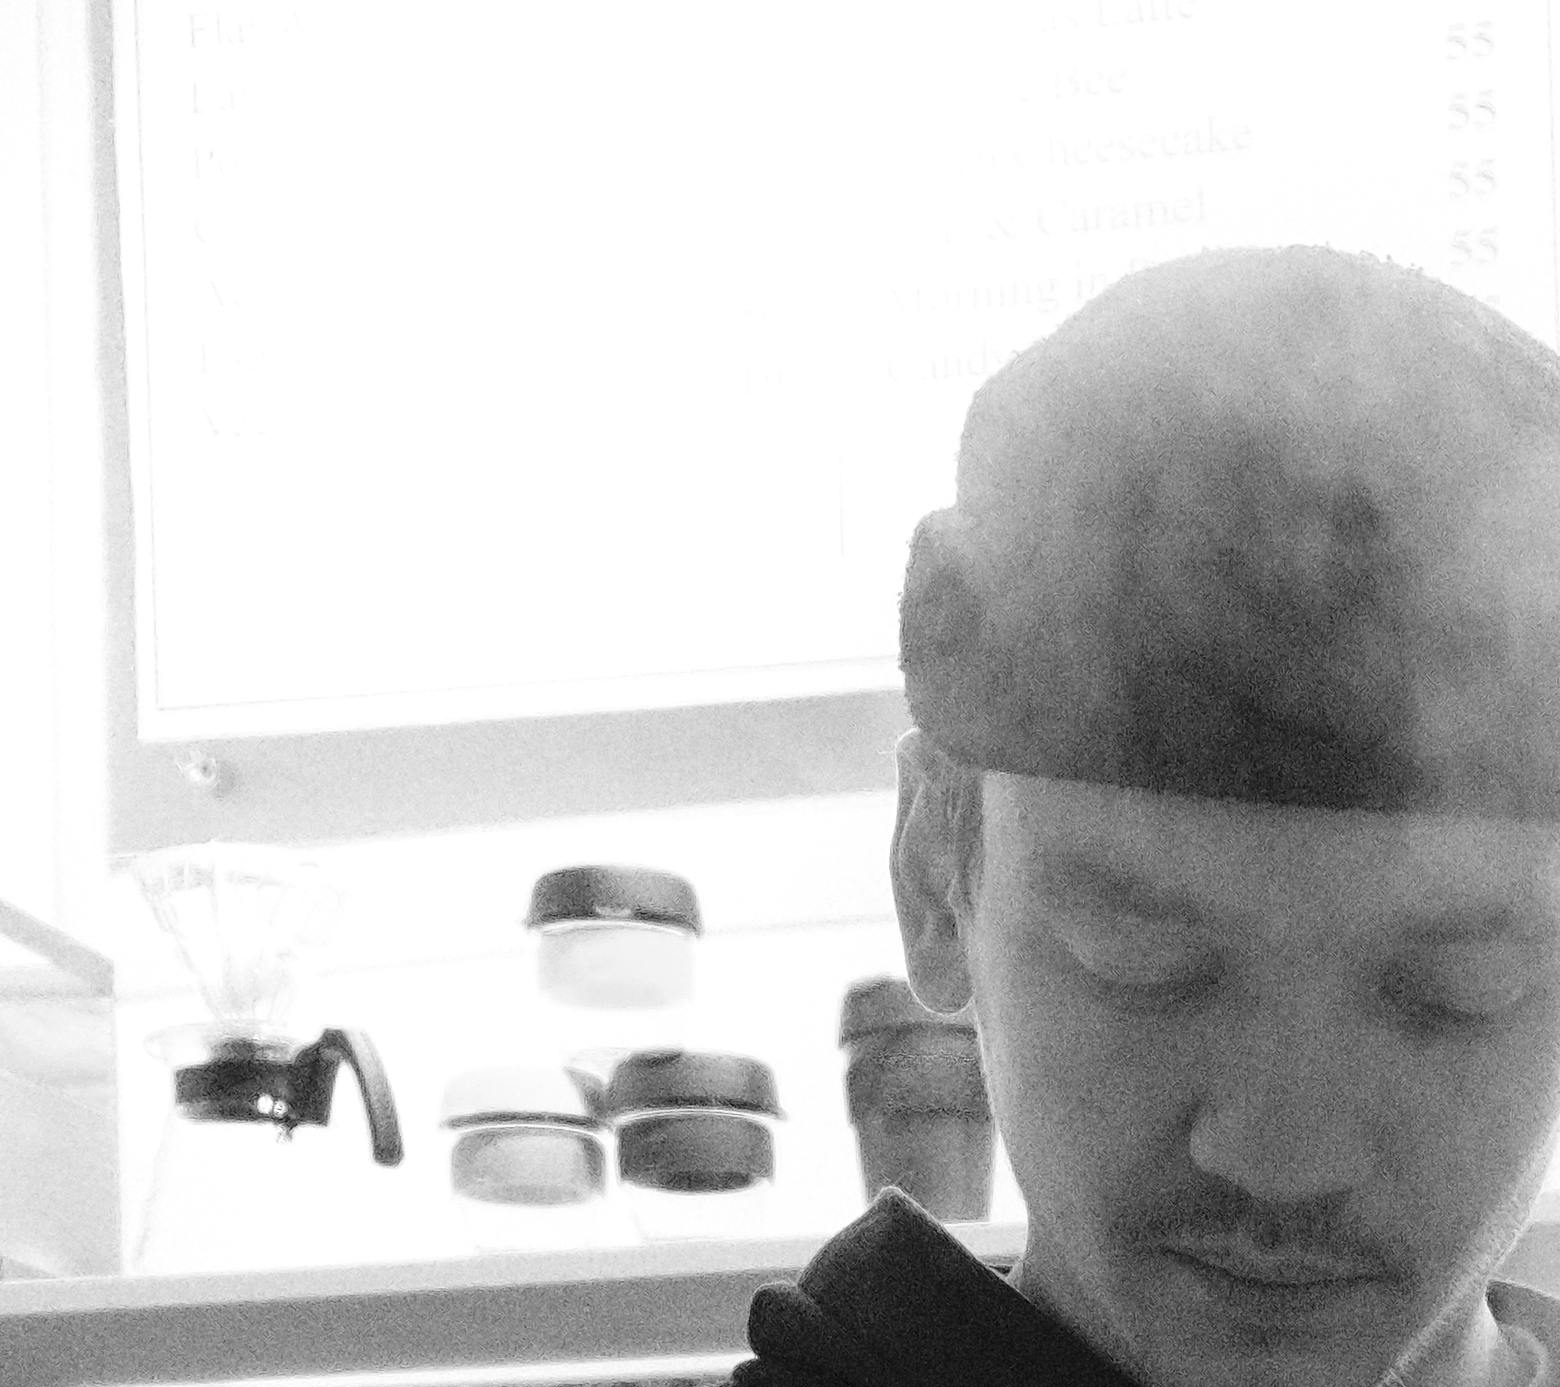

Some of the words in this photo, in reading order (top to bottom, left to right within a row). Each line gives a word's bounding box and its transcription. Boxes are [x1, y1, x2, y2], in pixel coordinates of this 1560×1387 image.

[1444, 18, 1497, 63] 55
[1446, 86, 1499, 133] 55
[1447, 155, 1500, 201] 55
[1448, 224, 1502, 272] 55
